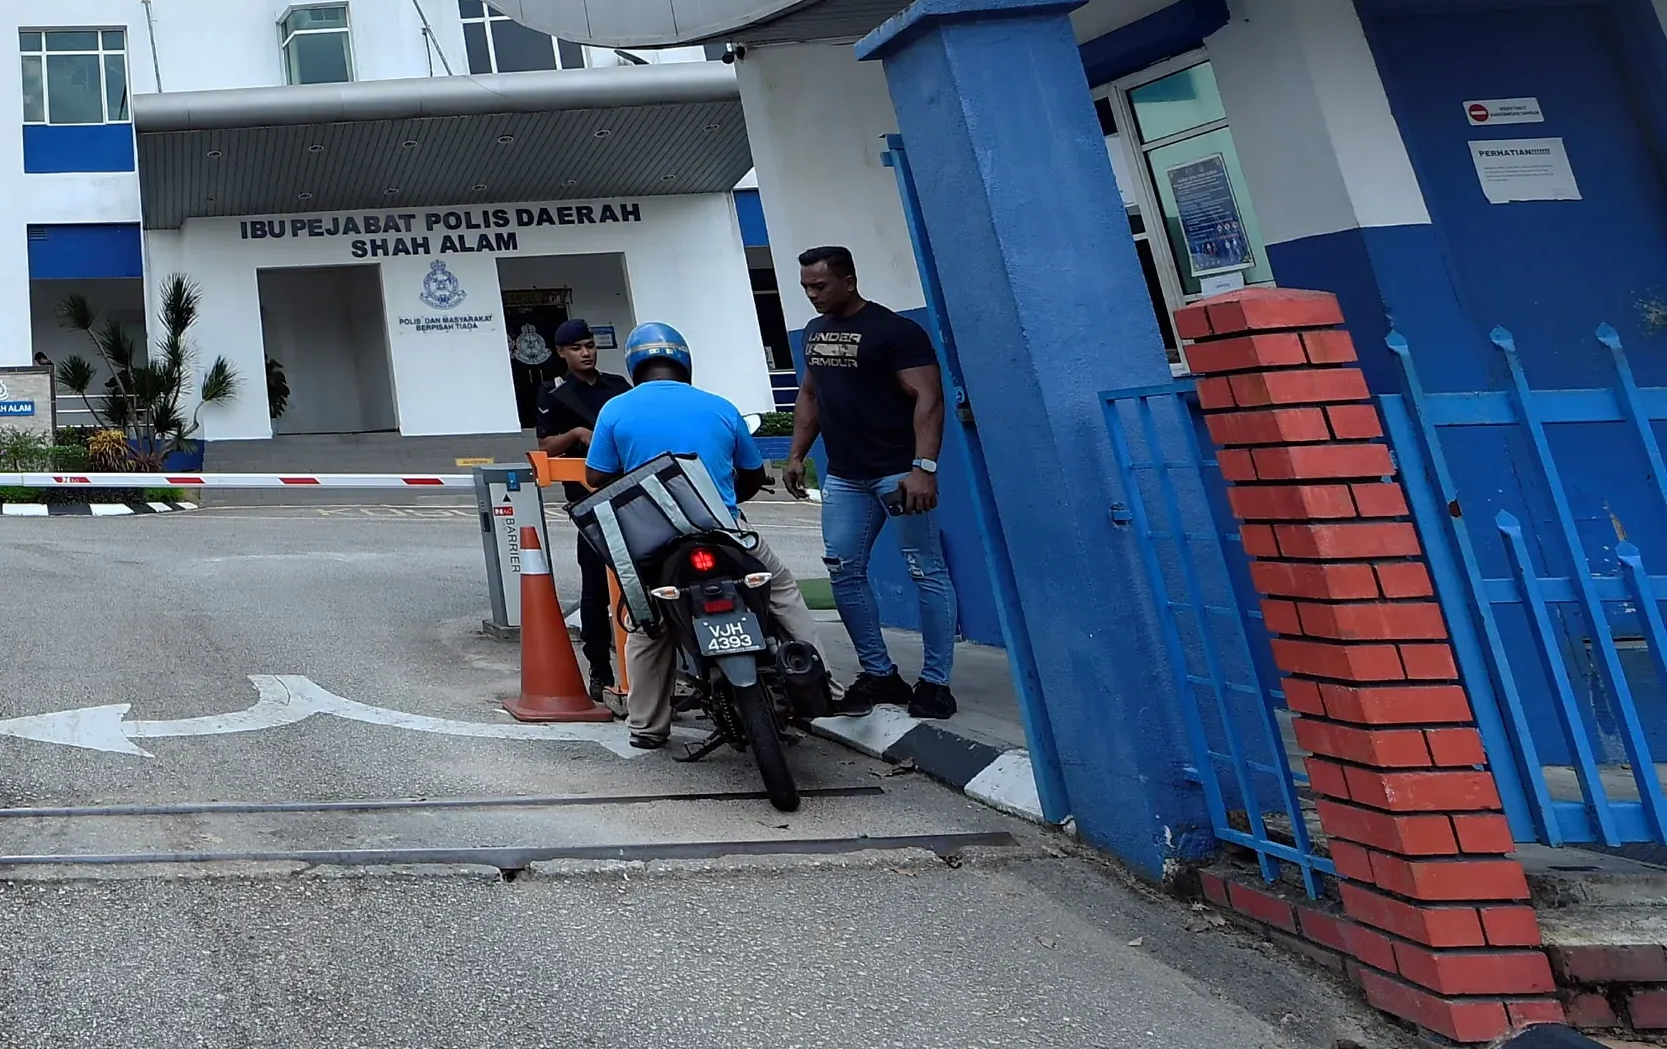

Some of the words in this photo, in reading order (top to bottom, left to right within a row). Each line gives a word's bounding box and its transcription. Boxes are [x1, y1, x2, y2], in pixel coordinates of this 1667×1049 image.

[240, 220, 285, 239] IBU
[291, 214, 416, 238] PEJABAT
[425, 208, 510, 232] POLIS
[515, 203, 642, 227] DAERAH
[351, 236, 431, 258] SHAH
[440, 232, 518, 254] ALAM
[442, 315, 493, 325] MASYARAKAT
[456, 322, 478, 330] TIADA
[809, 332, 862, 343] UNDER
[8, 404, 32, 412] ALAM
[506, 518, 521, 573] BARRIER
[709, 622, 743, 638] VJH
[708, 634, 752, 650] 4393
